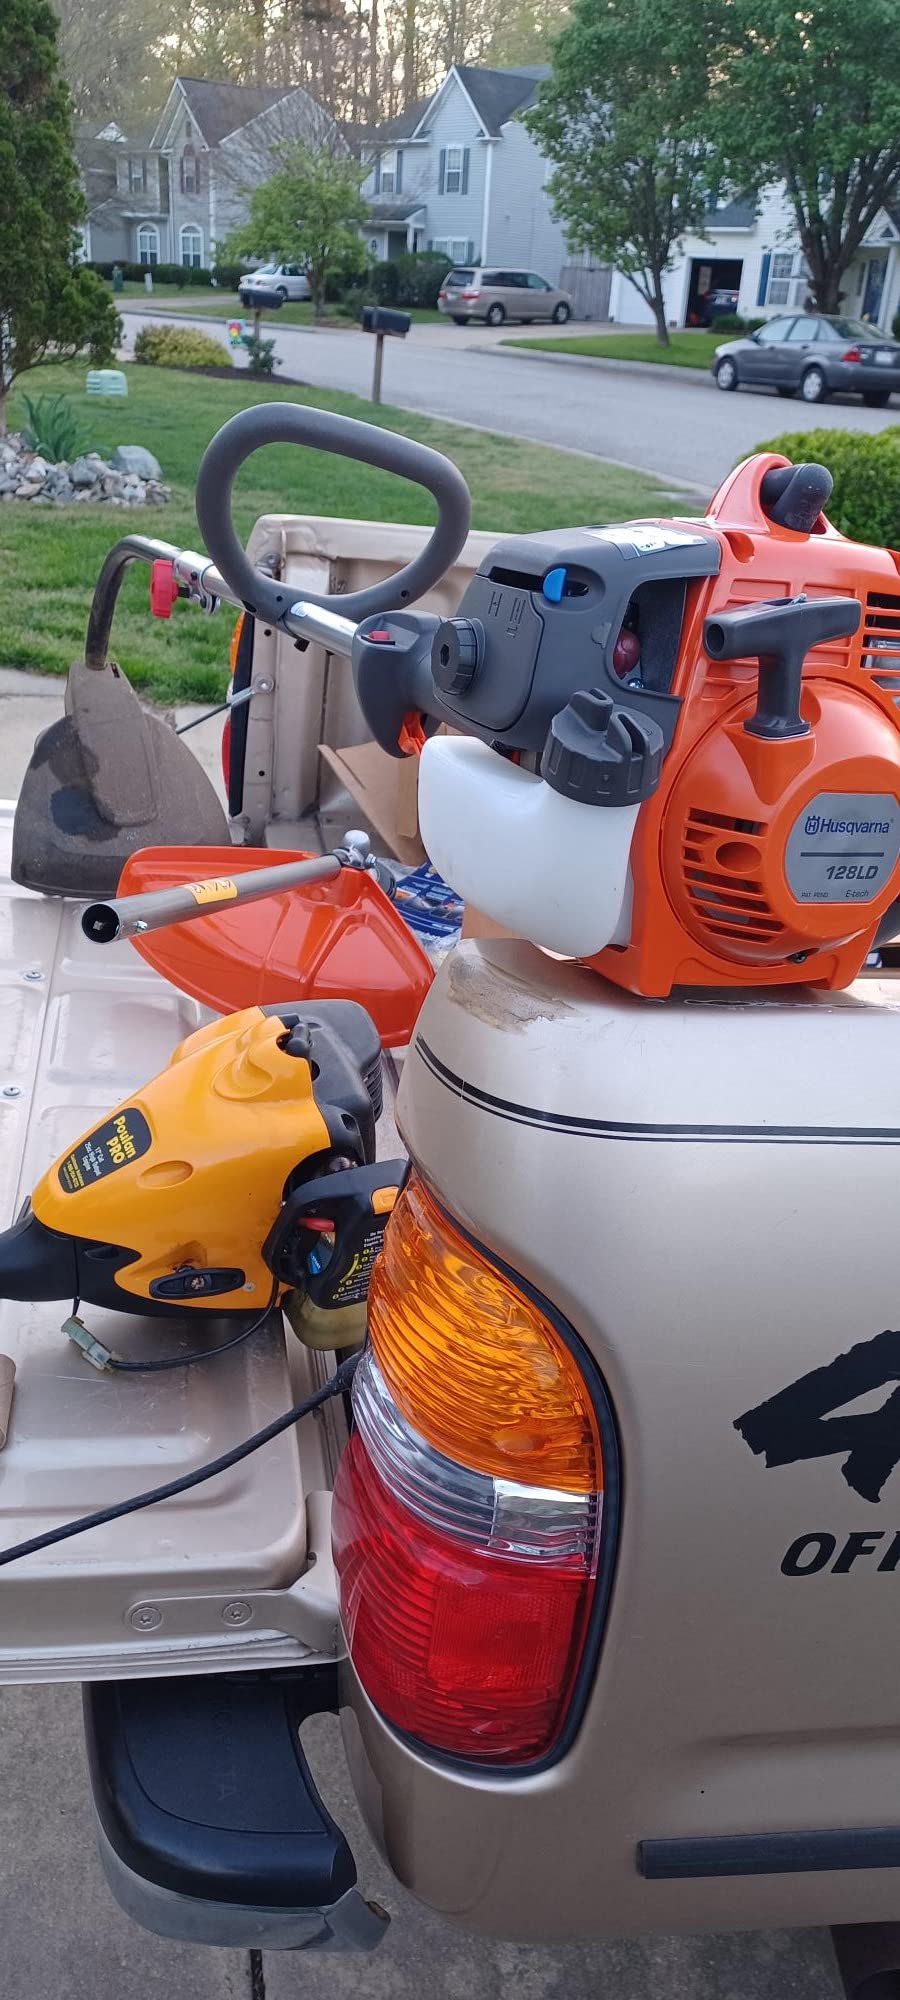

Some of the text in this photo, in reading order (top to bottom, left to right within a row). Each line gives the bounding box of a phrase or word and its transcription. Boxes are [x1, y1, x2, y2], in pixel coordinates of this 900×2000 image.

[820, 819, 890, 835] Husqvarna
[826, 865, 878, 880] 128LD
[113, 1115, 137, 1159] Poulan
[106, 1136, 125, 1164] PRO
